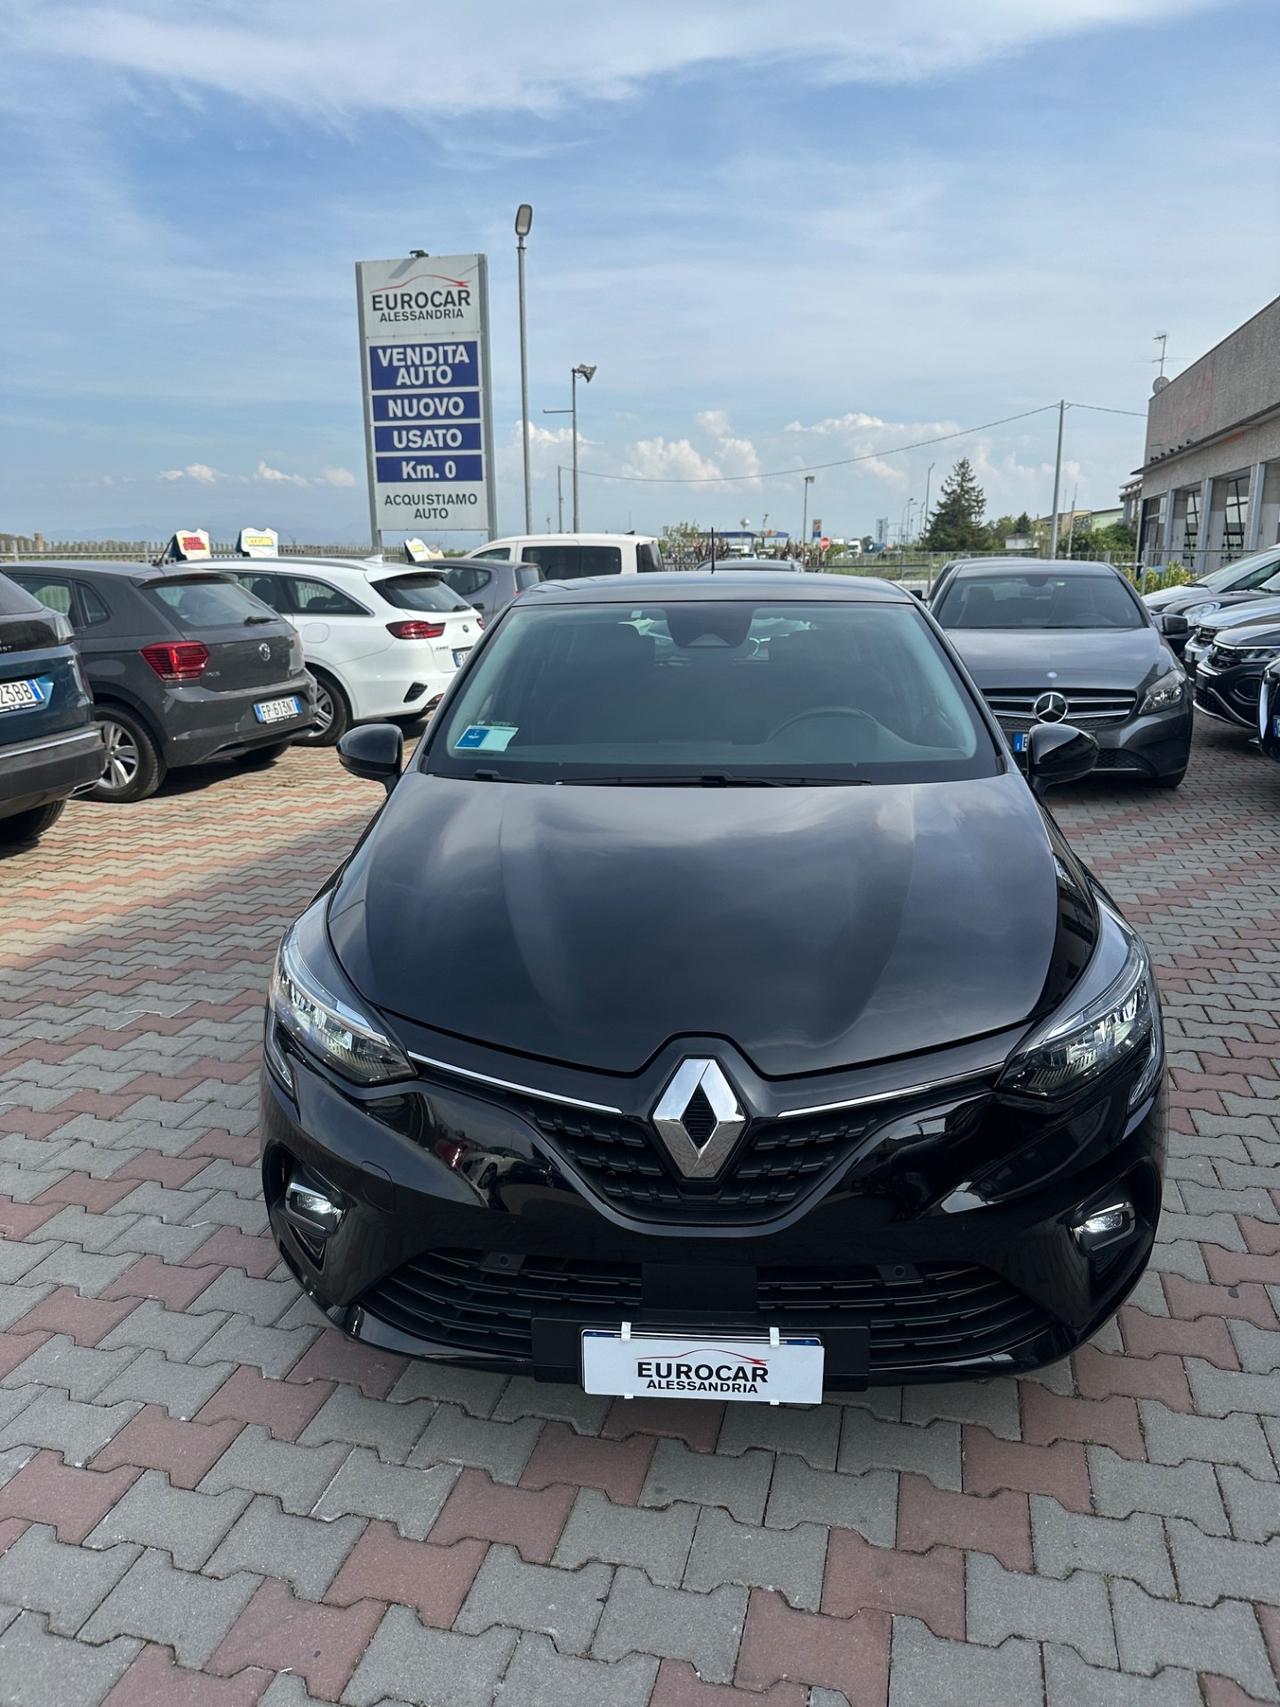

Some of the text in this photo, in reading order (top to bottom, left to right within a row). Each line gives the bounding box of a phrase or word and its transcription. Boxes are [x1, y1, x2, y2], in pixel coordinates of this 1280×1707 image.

[372, 289, 470, 311] EUROCAR
[380, 309, 464, 322] ALESSANDRIA
[378, 345, 470, 366] VENDITA
[397, 366, 452, 385] AUTO
[388, 397, 465, 417] NUOVO
[393, 429, 462, 448] USATO
[402, 461, 456, 479] Km. 0
[384, 493, 478, 506] ACQUISTIAMO
[414, 508, 449, 519] AUTO
[638, 1362, 768, 1383] EUROCAR
[646, 1380, 758, 1393] ALESSANDRIA
